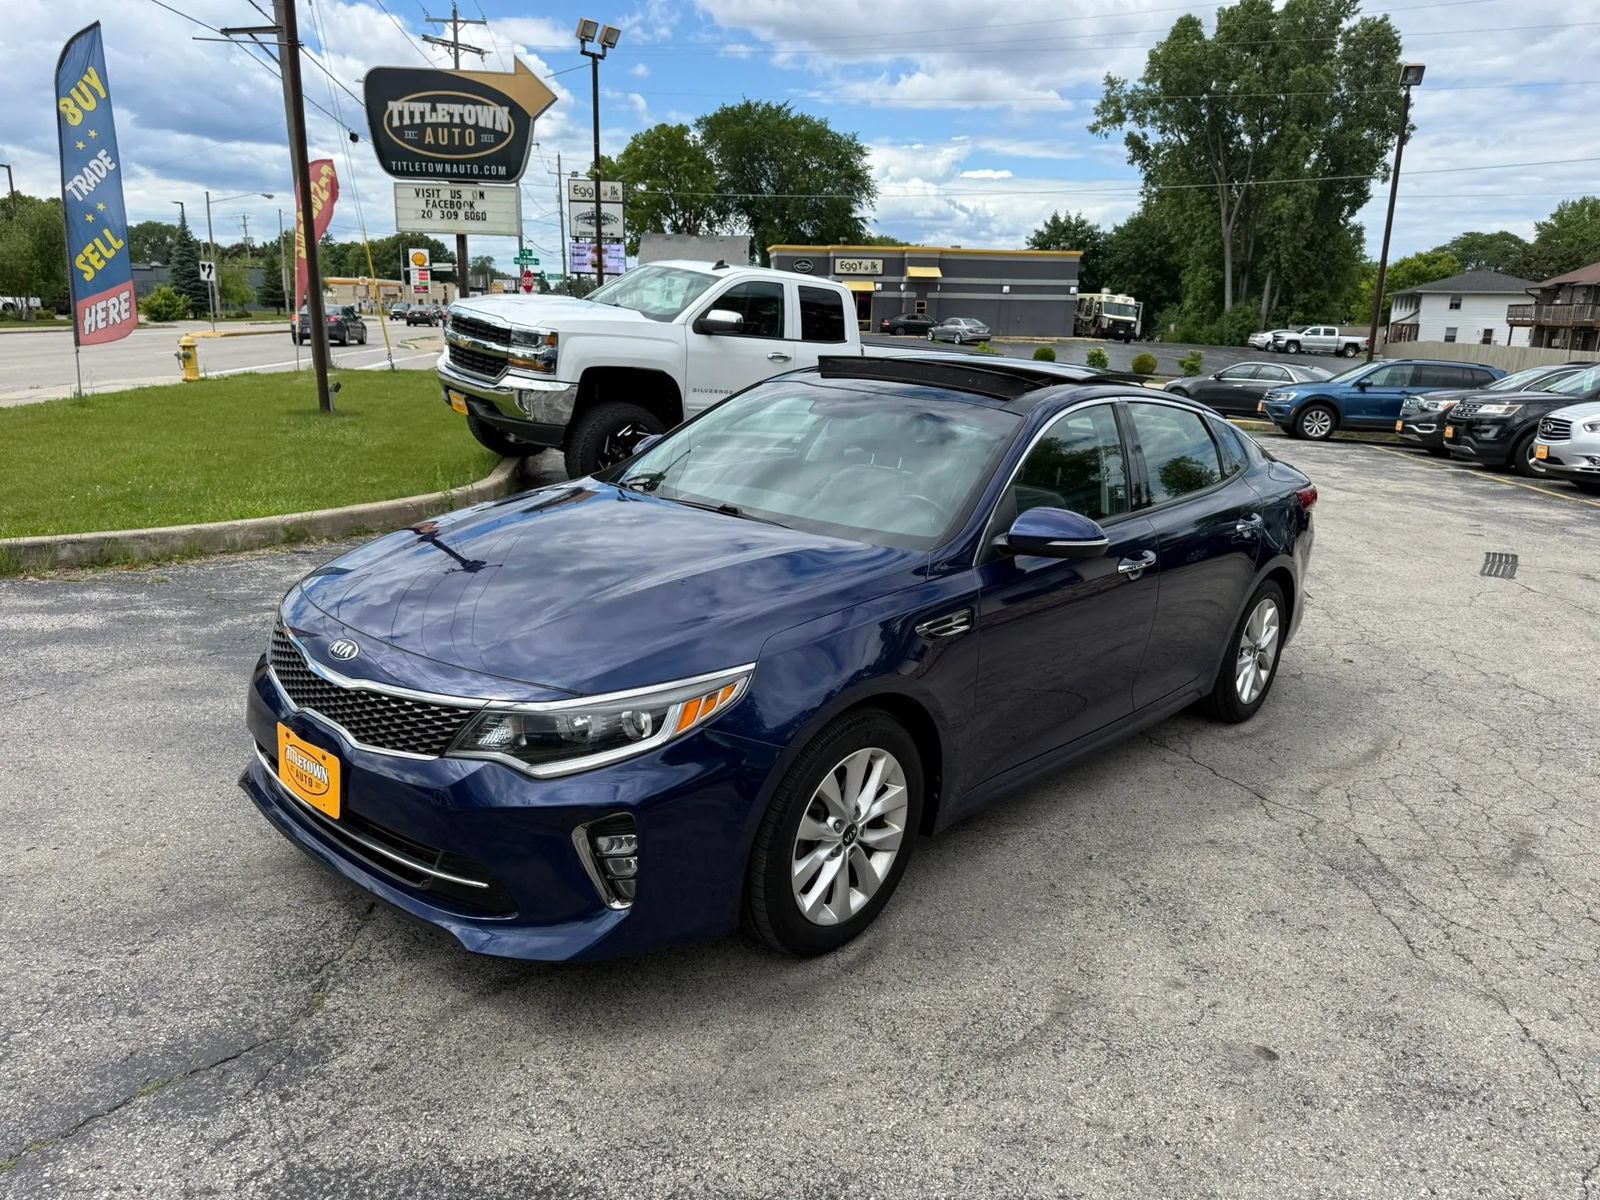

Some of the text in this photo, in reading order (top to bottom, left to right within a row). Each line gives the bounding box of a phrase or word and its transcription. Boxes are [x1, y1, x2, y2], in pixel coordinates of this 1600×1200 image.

[59, 66, 106, 126] BUY
[388, 101, 509, 133] TITLETOWN
[424, 127, 475, 146] AUTO
[65, 149, 116, 201] TRADE
[392, 161, 506, 176] TITLETOWNAUTO.COM
[415, 188, 485, 200] VISIT US ON
[425, 200, 475, 210] FACEBOOK
[440, 210, 458, 220] 309
[464, 211, 486, 221] 6060
[76, 228, 124, 281] SELL
[84, 290, 130, 335] HERE
[331, 640, 353, 658] KIA
[286, 744, 329, 785] TITLETOWN
[295, 769, 313, 788] AUTO
